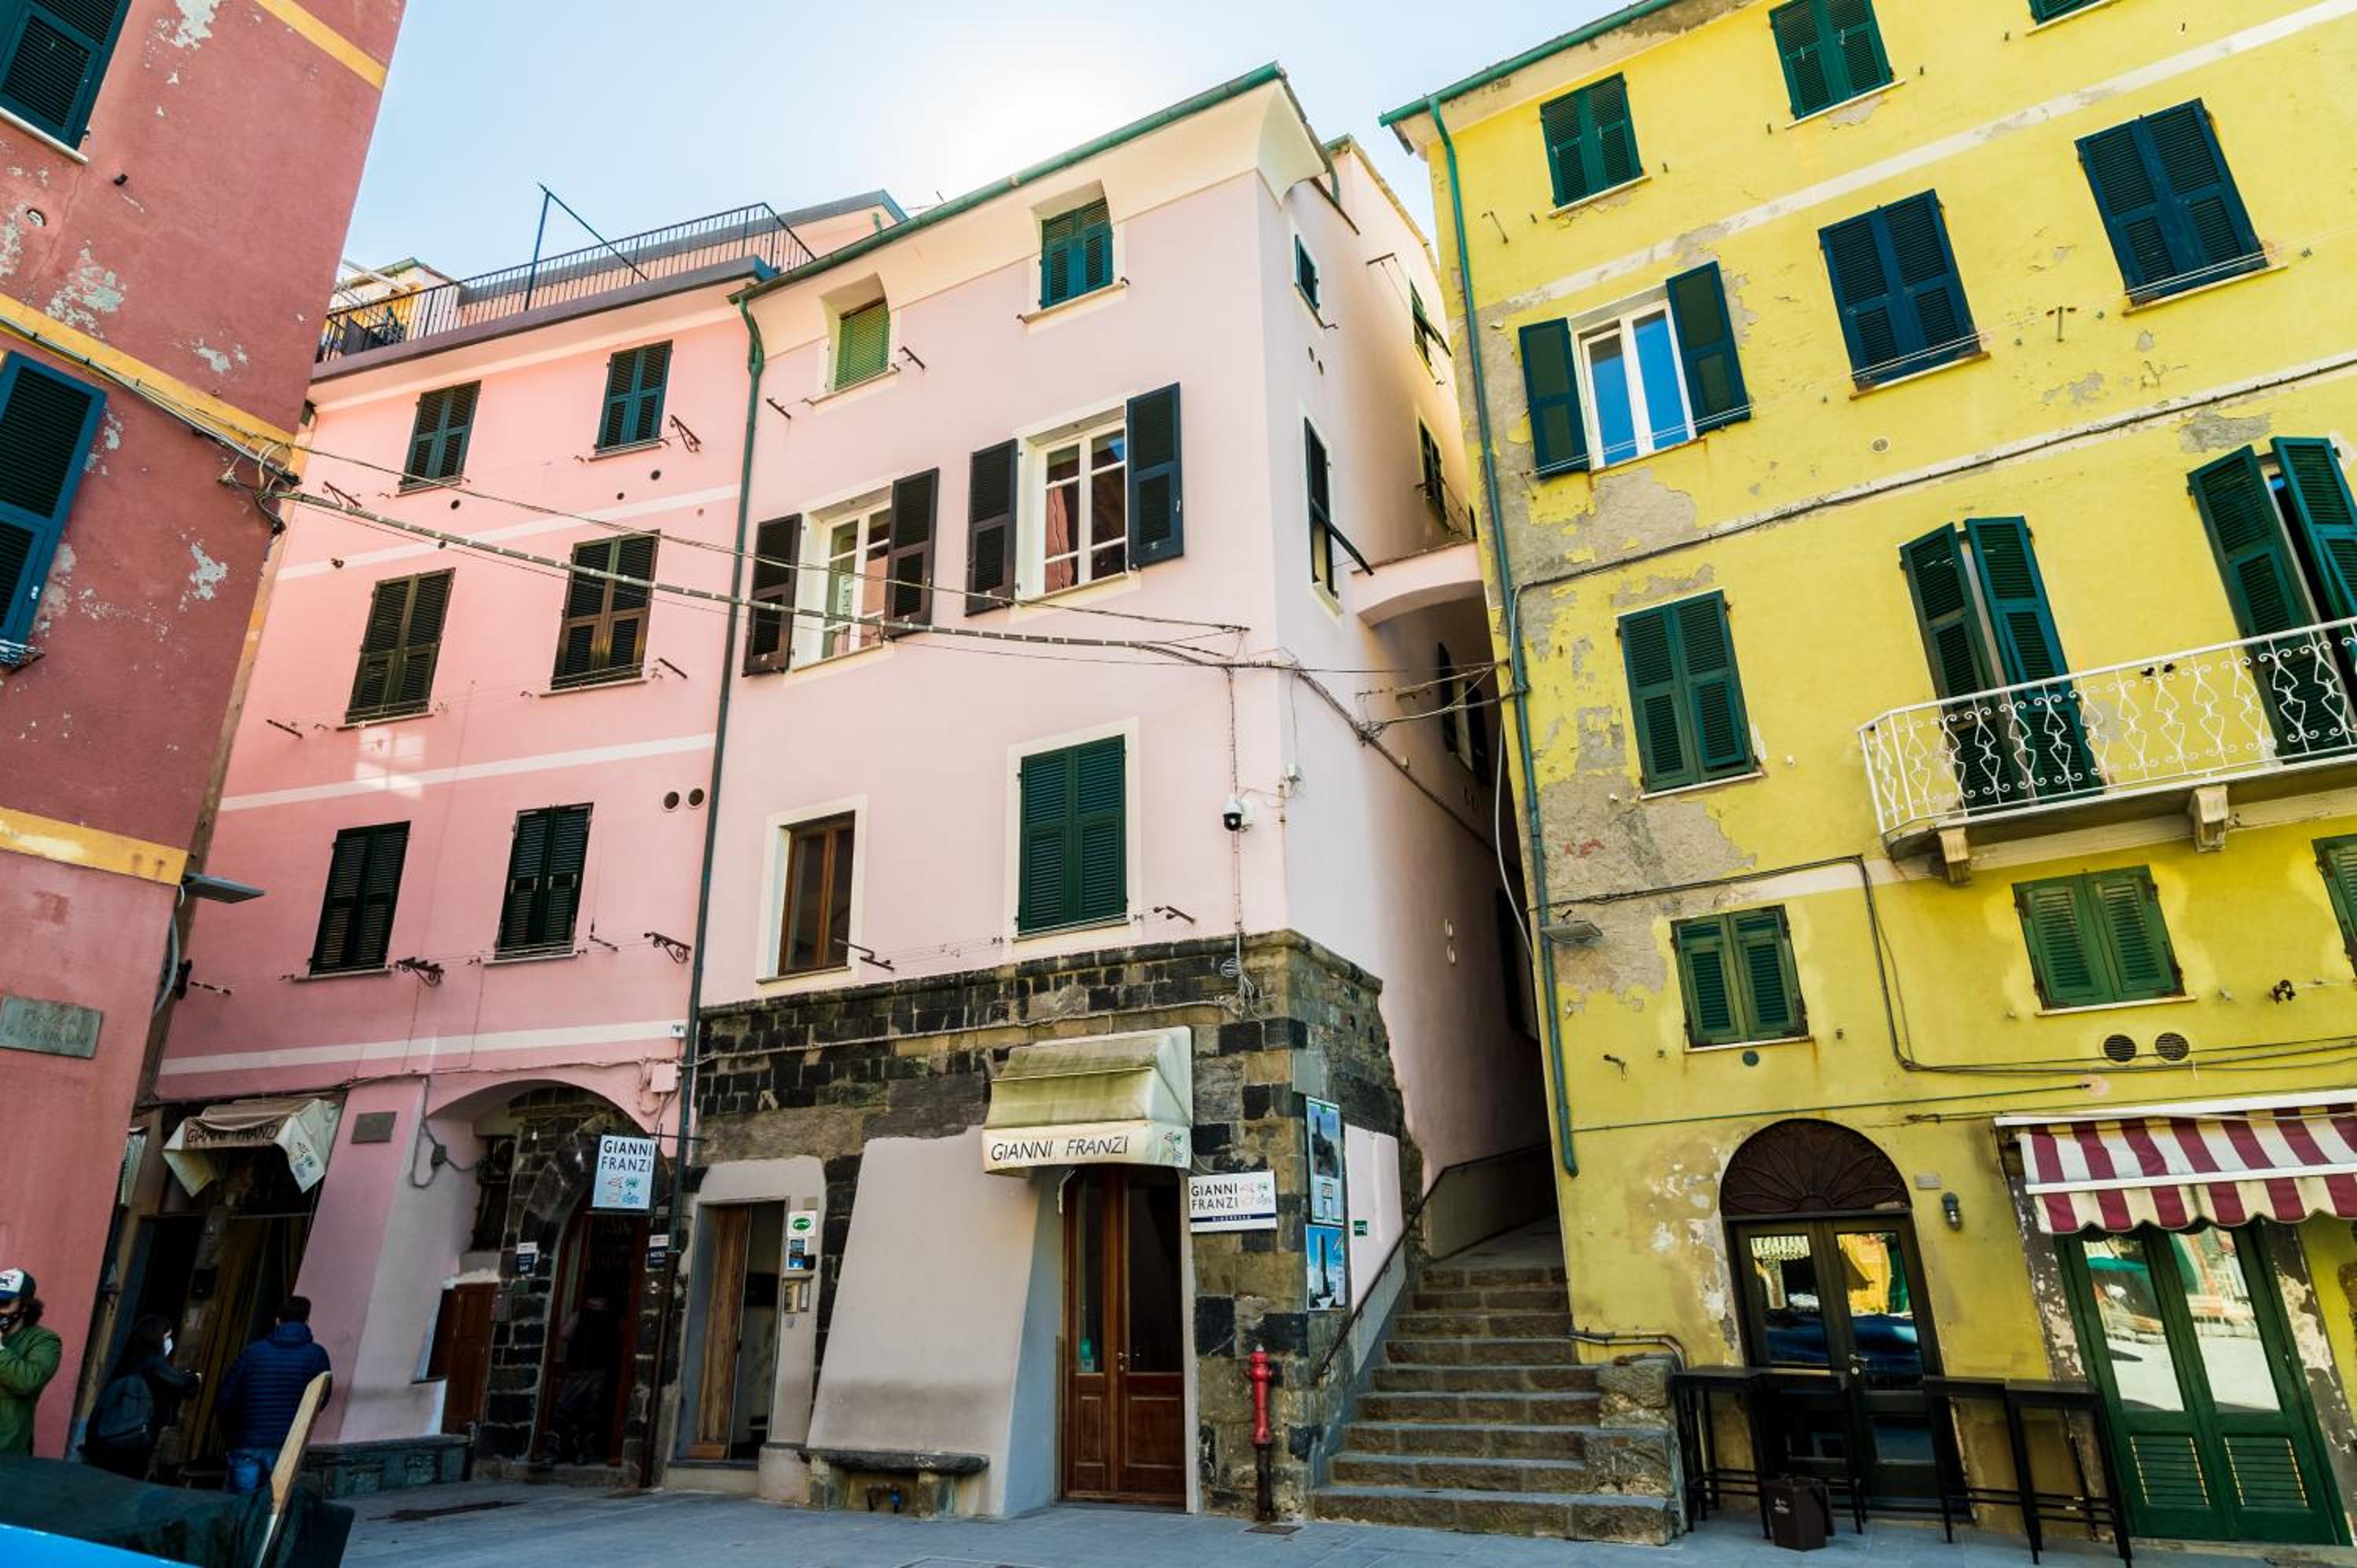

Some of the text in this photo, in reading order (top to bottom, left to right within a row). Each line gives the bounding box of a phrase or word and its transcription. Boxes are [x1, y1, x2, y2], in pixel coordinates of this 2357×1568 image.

[603, 1140, 653, 1156] GIANNI
[990, 1135, 1129, 1162] GIANNI FRANZI
[601, 1156, 651, 1173] FRANZI
[1191, 1182, 1238, 1196] GIANNI
[1192, 1196, 1238, 1210] FRANZI
